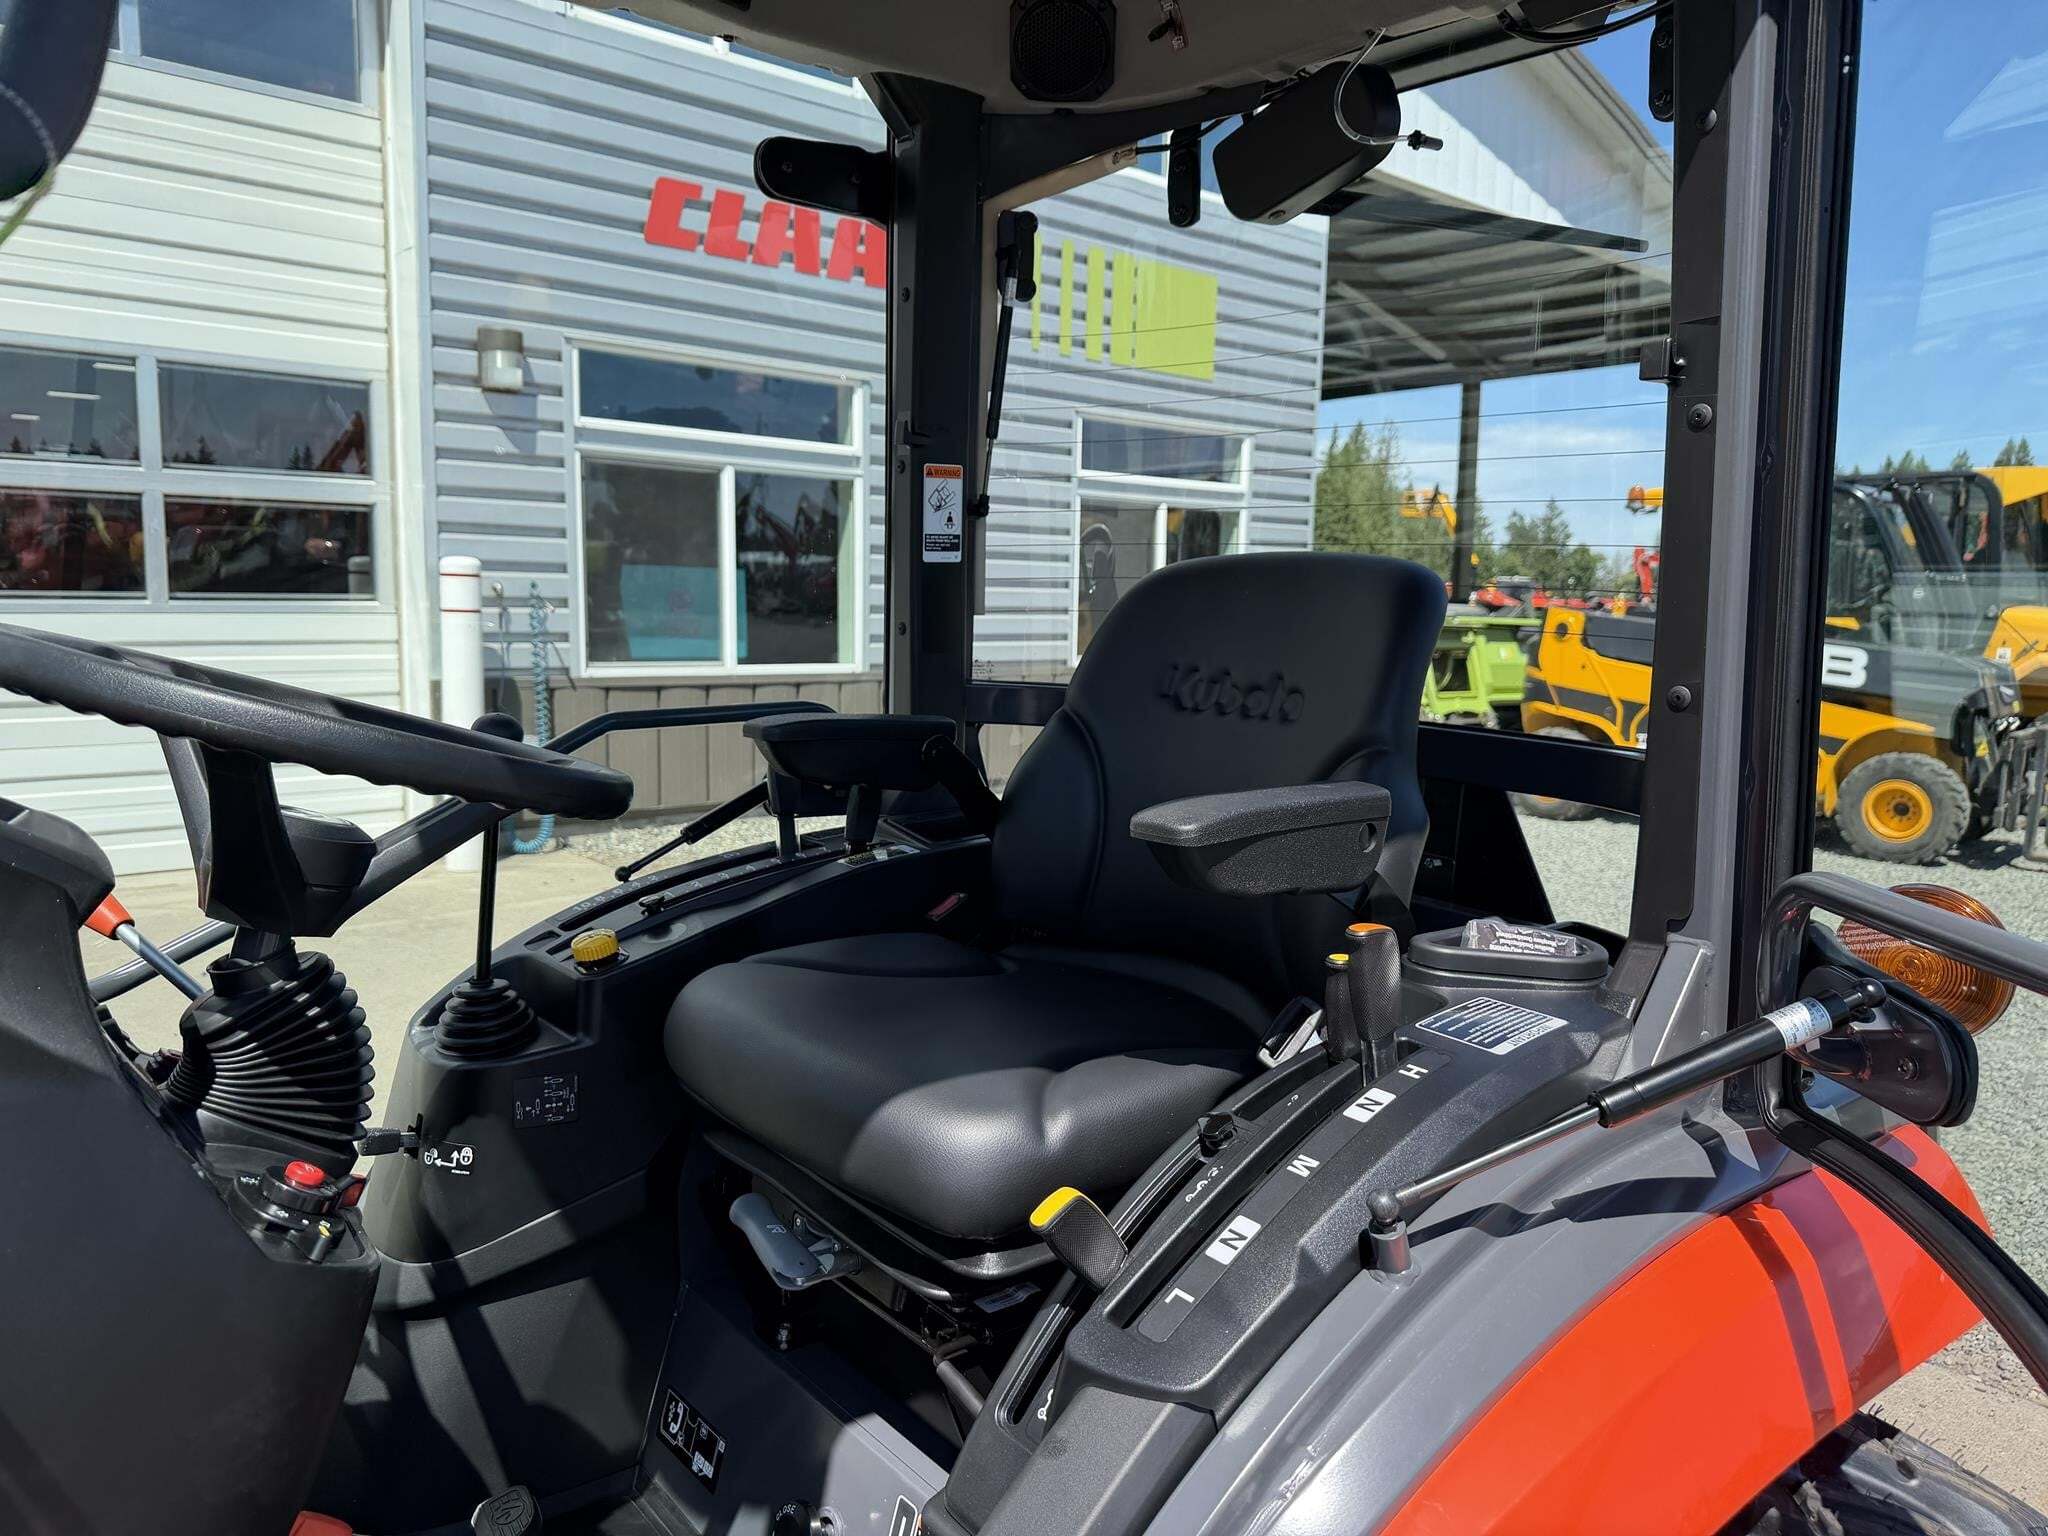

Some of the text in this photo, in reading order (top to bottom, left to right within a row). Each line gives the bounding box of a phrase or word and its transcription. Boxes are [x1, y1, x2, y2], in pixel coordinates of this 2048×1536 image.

[1160, 663, 1305, 723] Kubota
[1398, 1063, 1428, 1079] H
[1354, 1096, 1385, 1113] N
[1286, 1154, 1320, 1178] M
[1217, 1228, 1249, 1251] N
[1164, 1287, 1195, 1304] L
[775, 1503, 796, 1521] CLOSE
